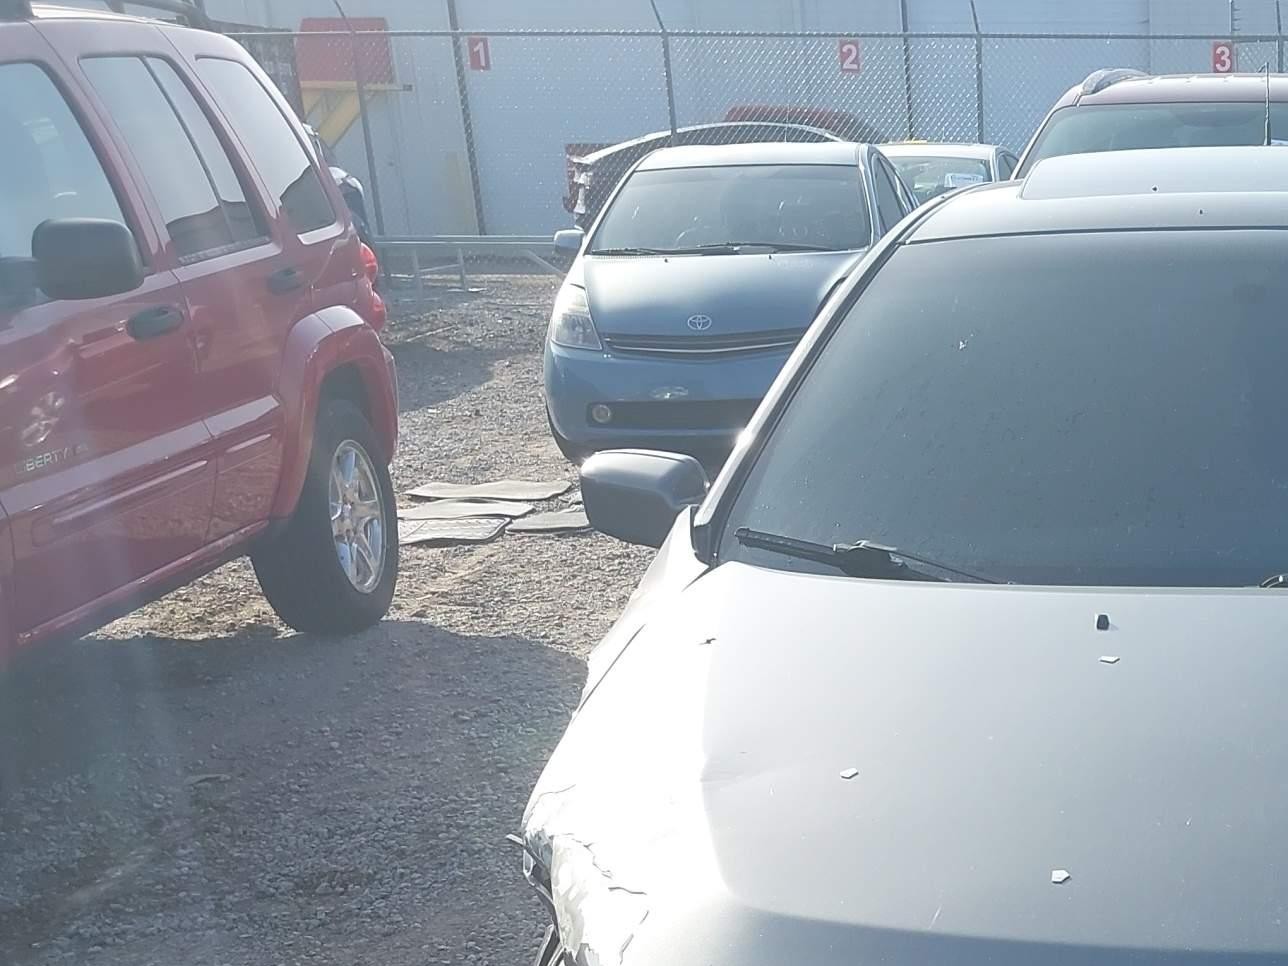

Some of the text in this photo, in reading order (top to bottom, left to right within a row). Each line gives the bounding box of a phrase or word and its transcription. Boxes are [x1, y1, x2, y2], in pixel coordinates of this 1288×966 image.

[473, 41, 485, 67] 1
[842, 44, 858, 70] 2
[1215, 46, 1231, 71] 3
